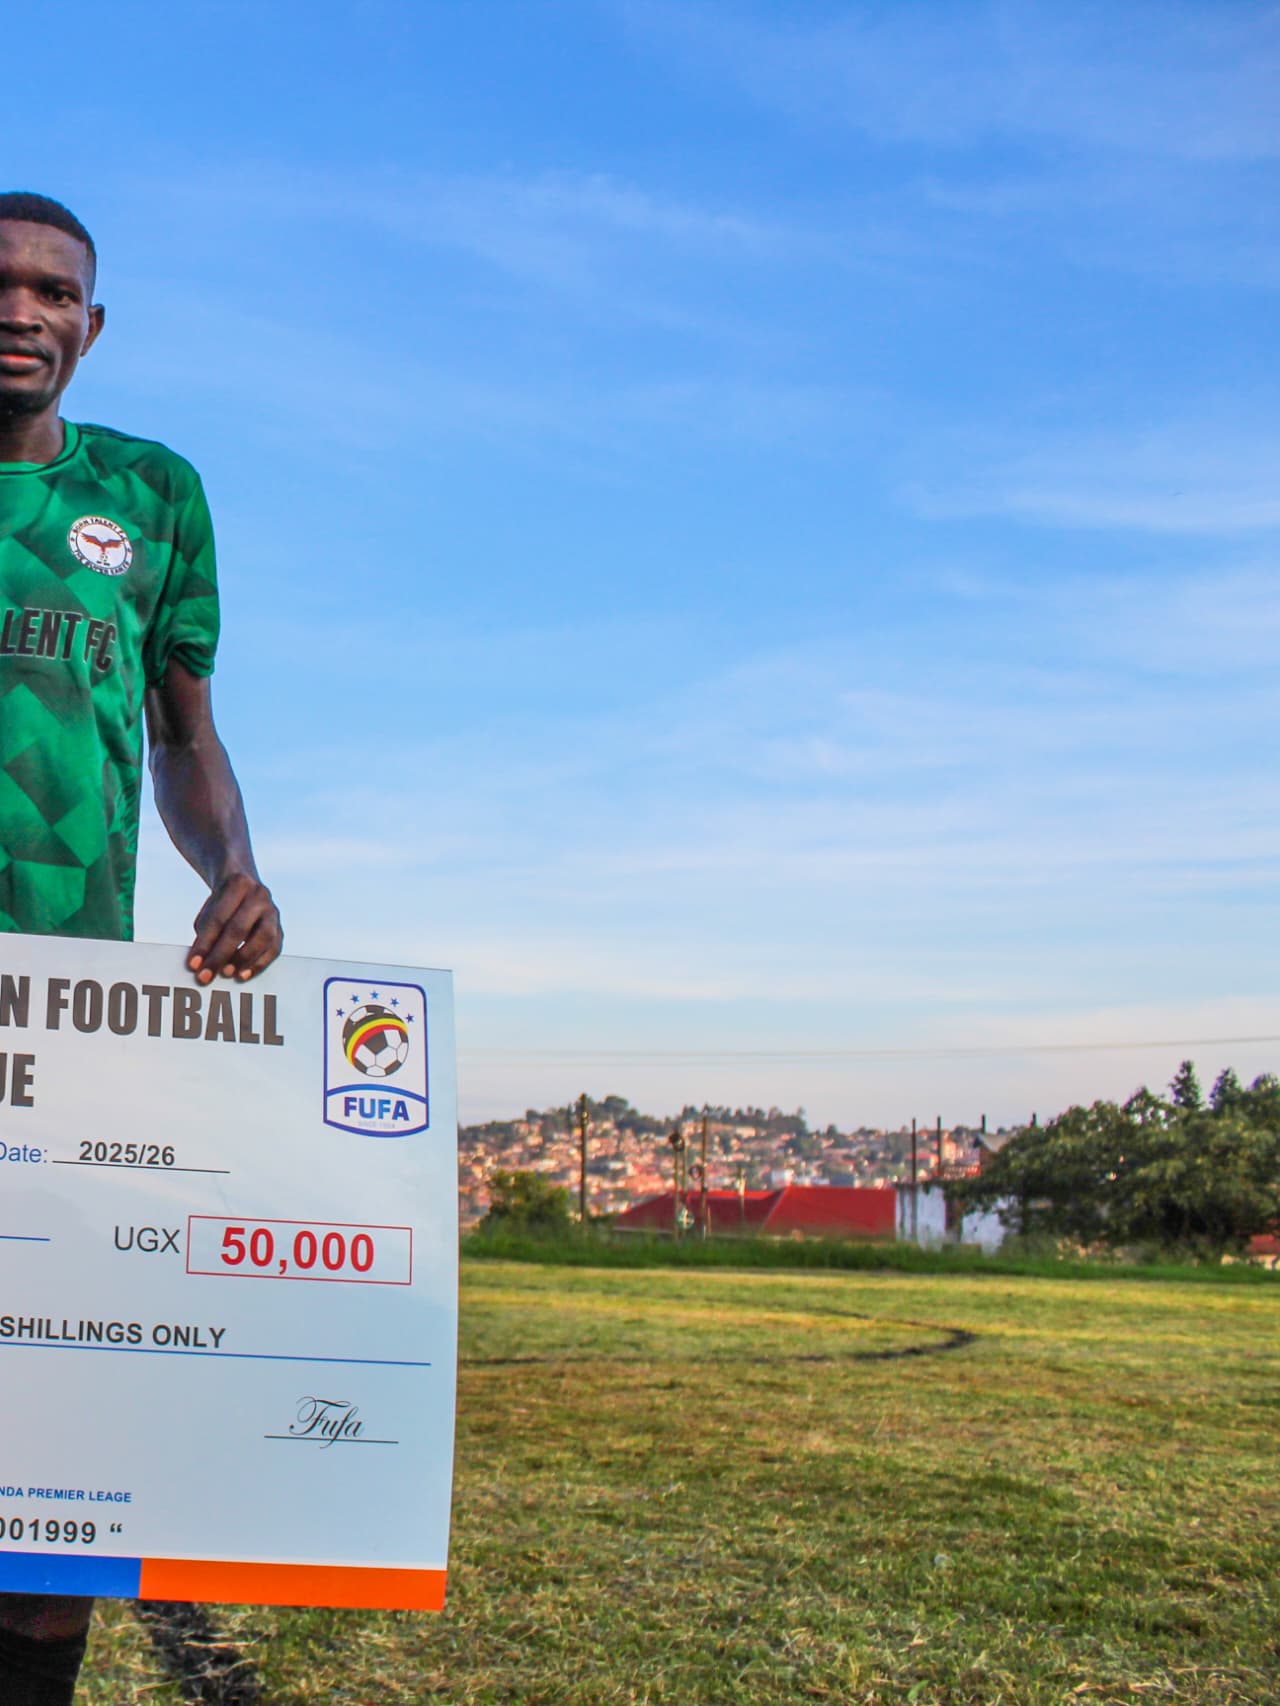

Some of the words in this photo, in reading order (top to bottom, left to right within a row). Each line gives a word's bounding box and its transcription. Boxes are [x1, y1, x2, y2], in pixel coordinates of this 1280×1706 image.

[83, 616, 117, 673] FC
[46, 978, 284, 1046] FOOTBALL
[344, 1097, 410, 1121] FUFA
[79, 1141, 175, 1166] 2025/26
[114, 1225, 181, 1253] UGX
[221, 1226, 375, 1274] 50,000
[0, 1315, 142, 1344] SHILLINGS
[152, 1324, 226, 1348] ONLY
[289, 1396, 364, 1449] Fufa
[28, 1487, 85, 1501] PREMIER
[89, 1490, 132, 1503] LEAGE
